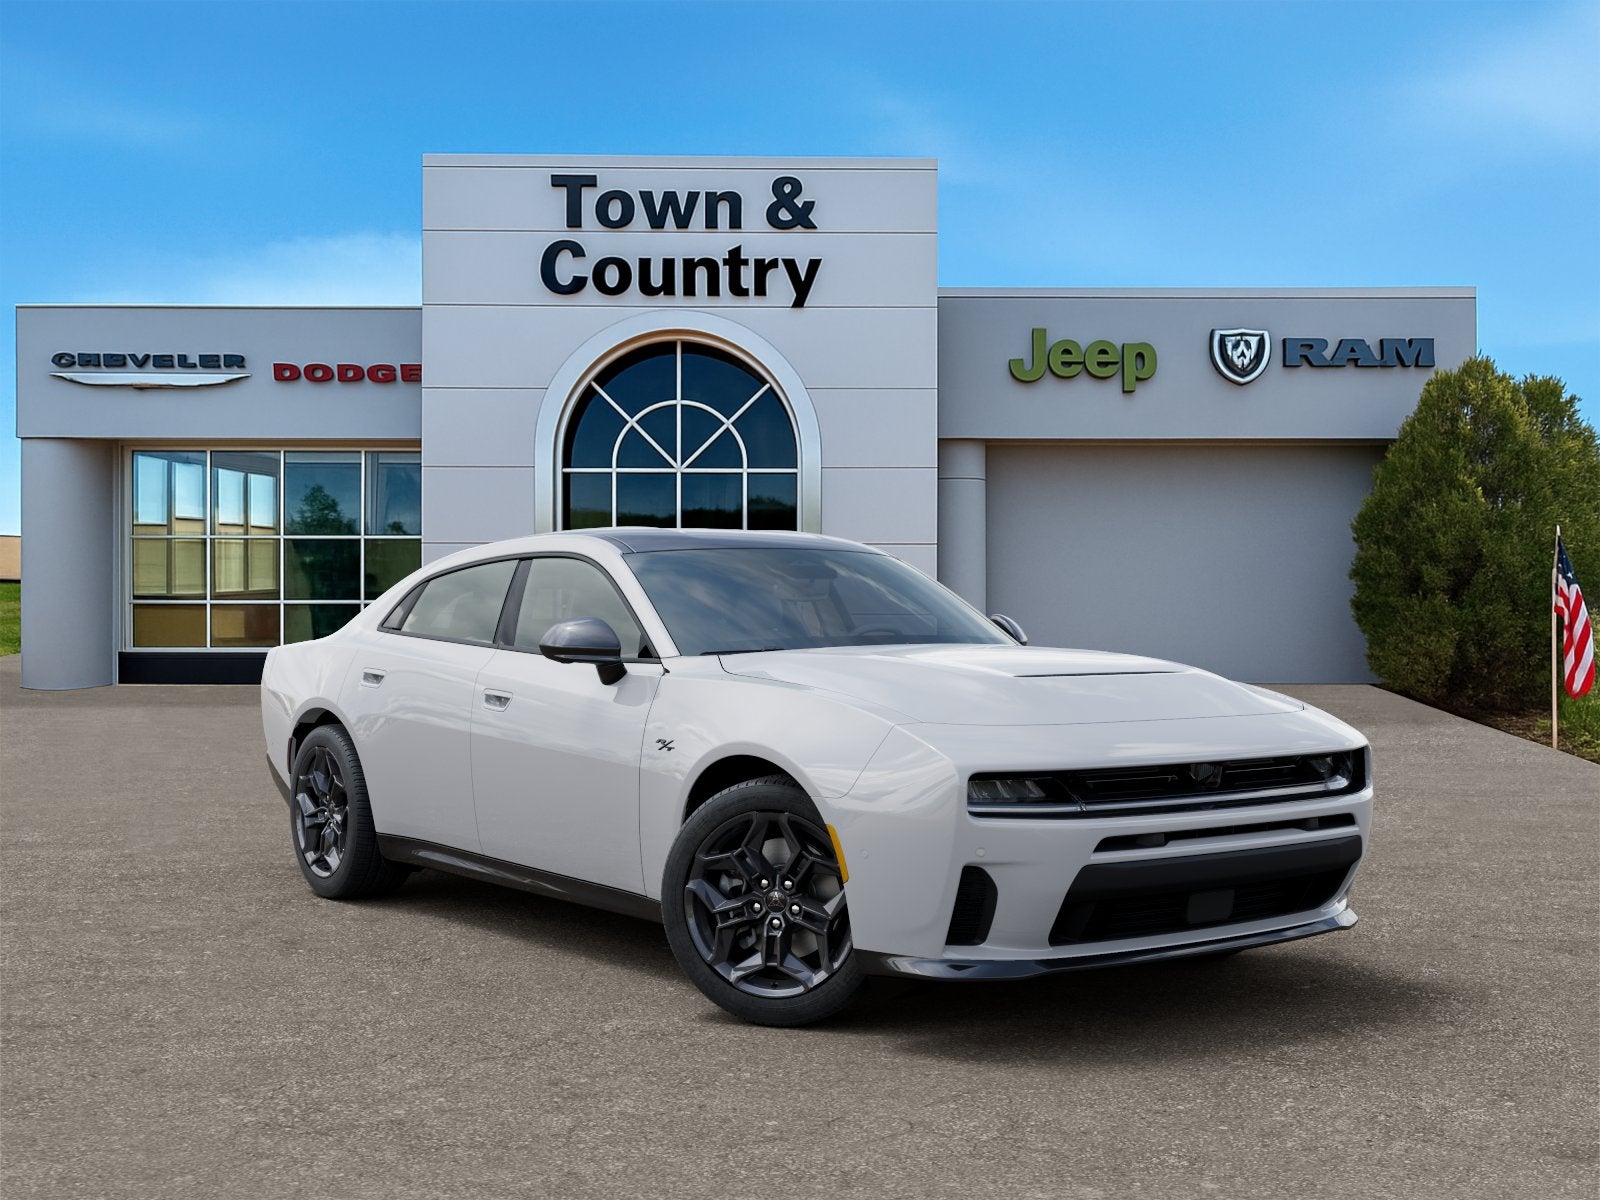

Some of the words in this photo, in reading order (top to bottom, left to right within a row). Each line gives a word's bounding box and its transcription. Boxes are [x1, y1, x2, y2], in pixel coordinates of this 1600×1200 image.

[551, 174, 742, 229] Town
[765, 176, 818, 230] &
[540, 239, 822, 308] Country
[273, 363, 422, 383] DODGE
[1009, 328, 1157, 392] Jeep
[1282, 338, 1435, 367] RAM
